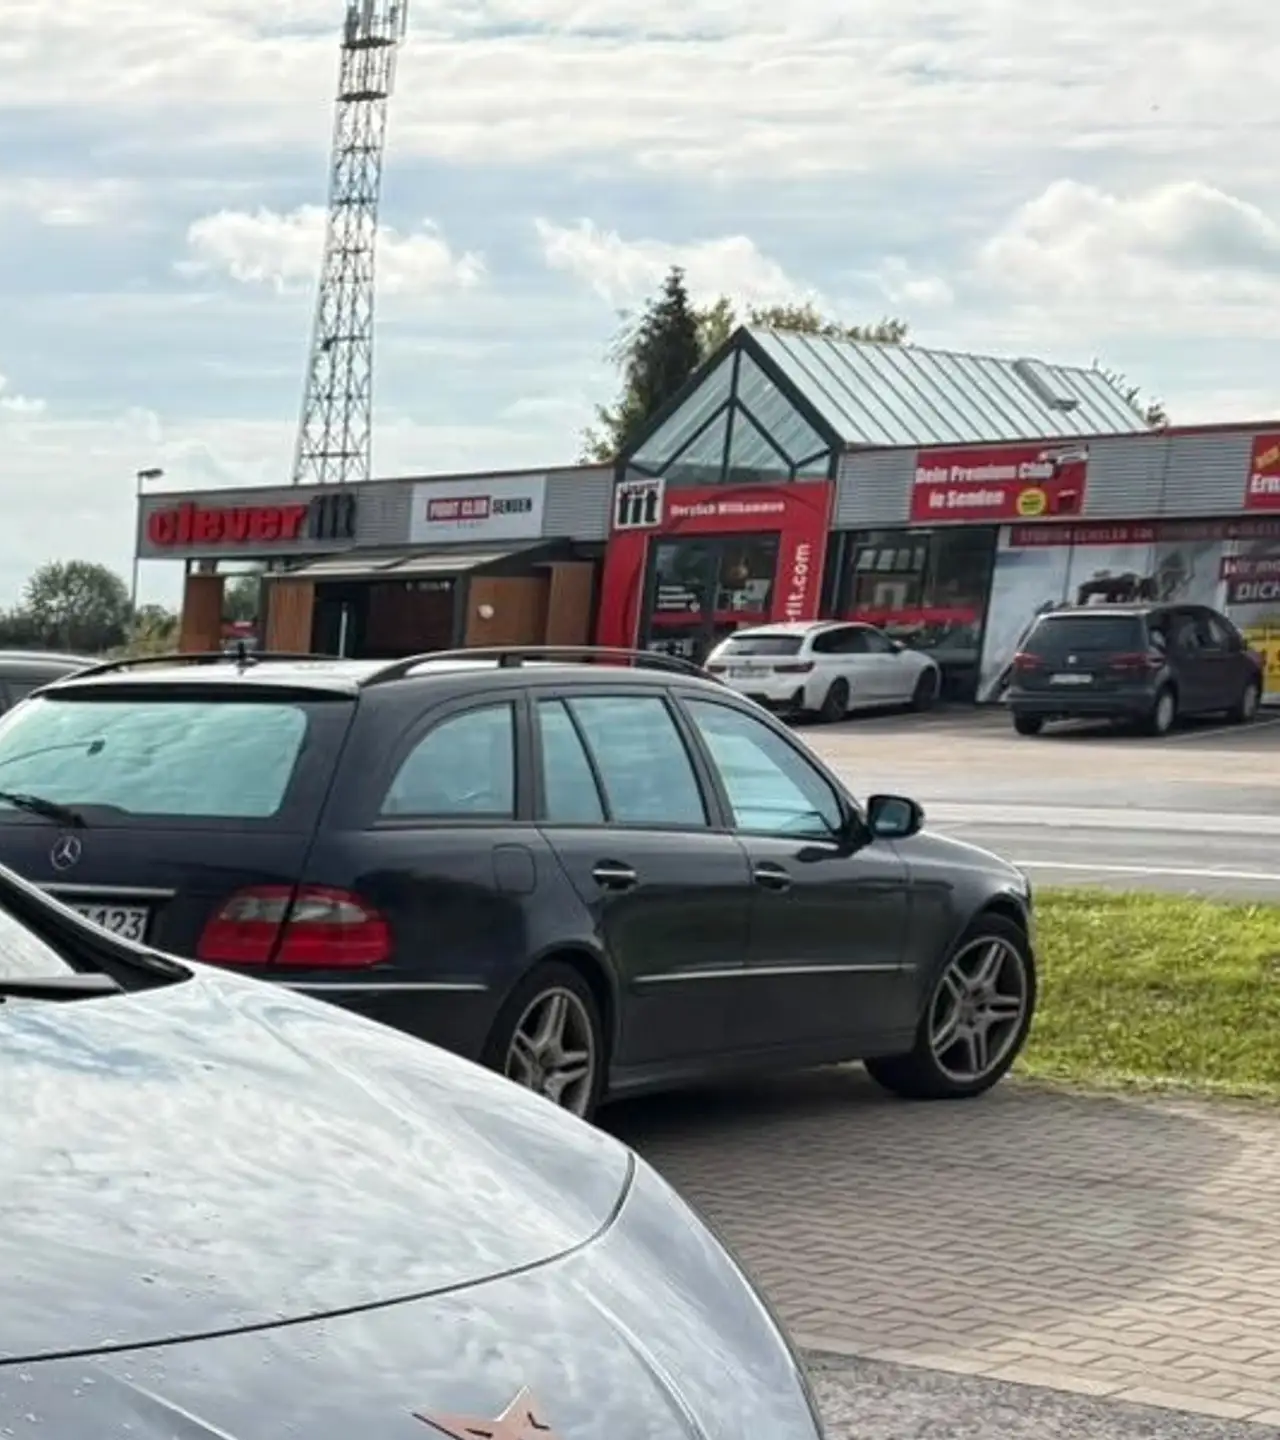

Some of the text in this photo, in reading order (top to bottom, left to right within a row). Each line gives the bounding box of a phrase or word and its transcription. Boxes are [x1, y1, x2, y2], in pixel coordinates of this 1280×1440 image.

[915, 461, 1053, 484] Dein Premium Club
[718, 501, 786, 514] Willkommen
[947, 488, 1006, 508] Senden
[146, 492, 358, 549] clever fit
